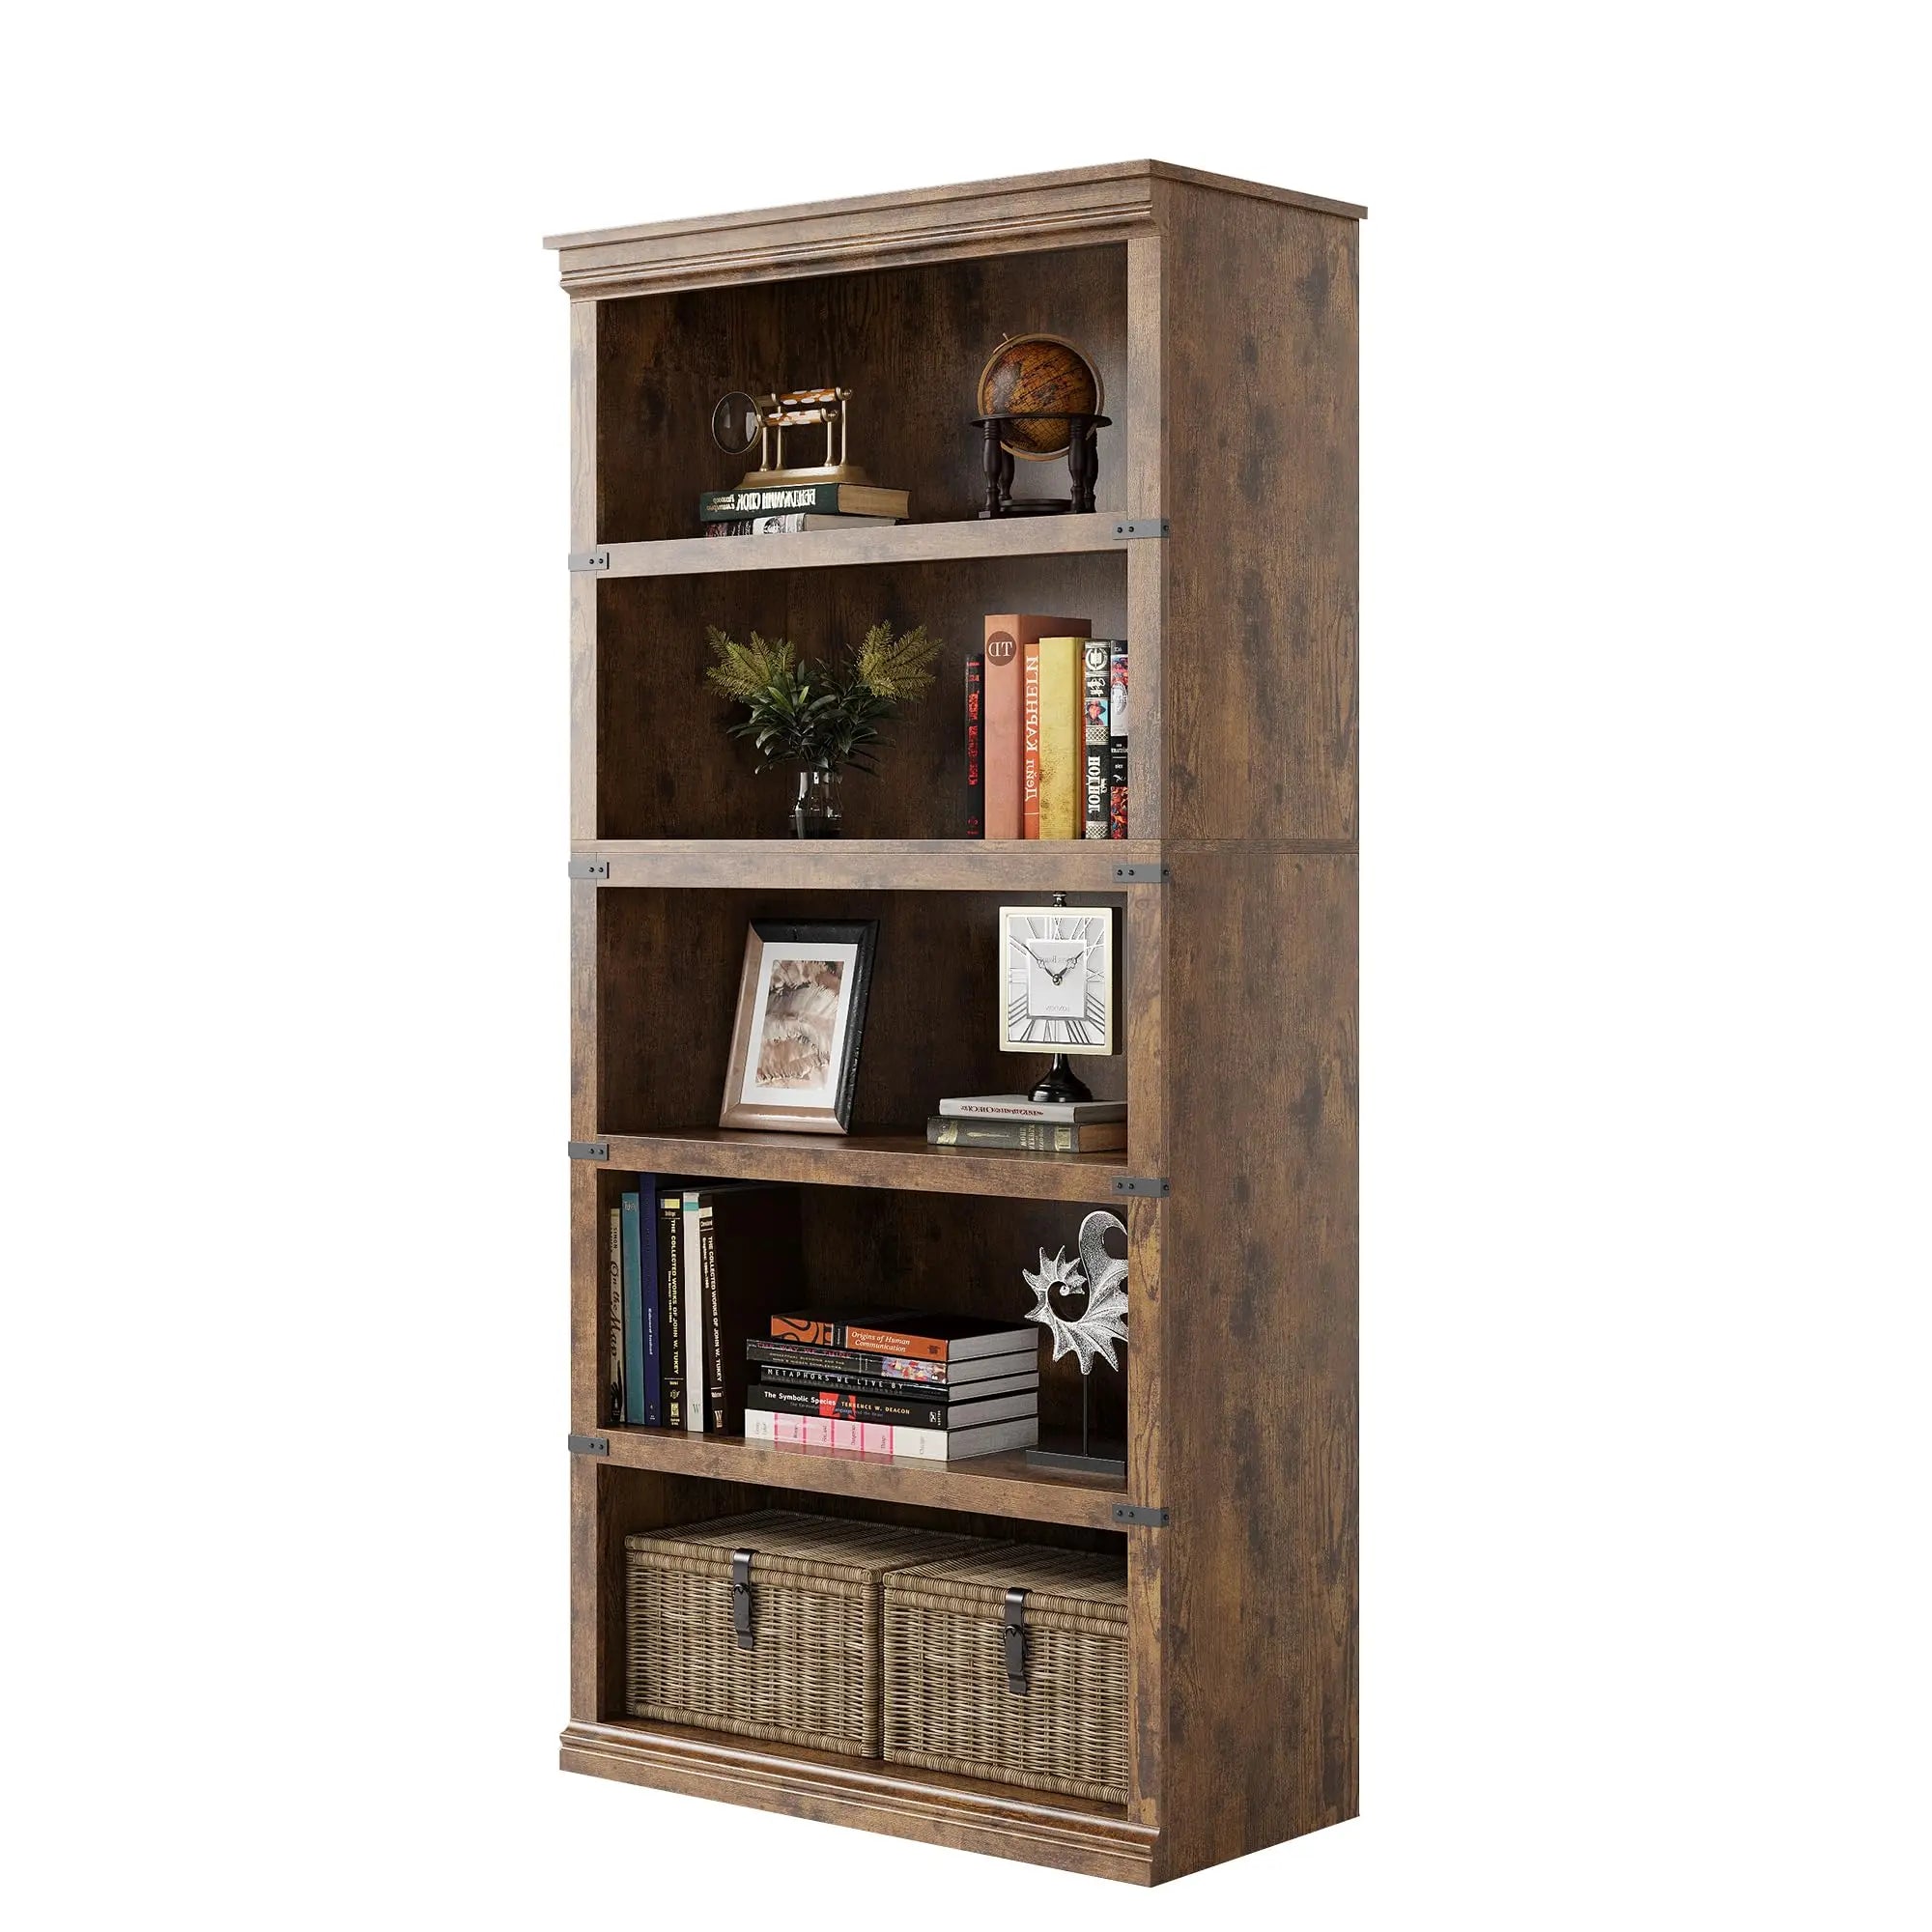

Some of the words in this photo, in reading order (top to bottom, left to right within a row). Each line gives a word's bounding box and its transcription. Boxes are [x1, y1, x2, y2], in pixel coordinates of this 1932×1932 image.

[611, 1261, 619, 1285] On
[672, 1307, 678, 1317] OF
[713, 1318, 719, 1326] OF
[673, 1339, 679, 1350] W.
[851, 1331, 875, 1342] Origins
[876, 1334, 885, 1343] of
[885, 1336, 910, 1345] Human
[855, 1340, 906, 1352] Communication
[715, 1348, 721, 1358] W.
[767, 1369, 830, 1381] METAPHORS
[838, 1375, 849, 1383] WE
[857, 1378, 883, 1388] LIVE
[779, 1392, 809, 1404] Symbolic
[810, 1396, 837, 1407] Species
[840, 1401, 872, 1410] TERRENCE
[886, 1406, 910, 1415] DEACON
